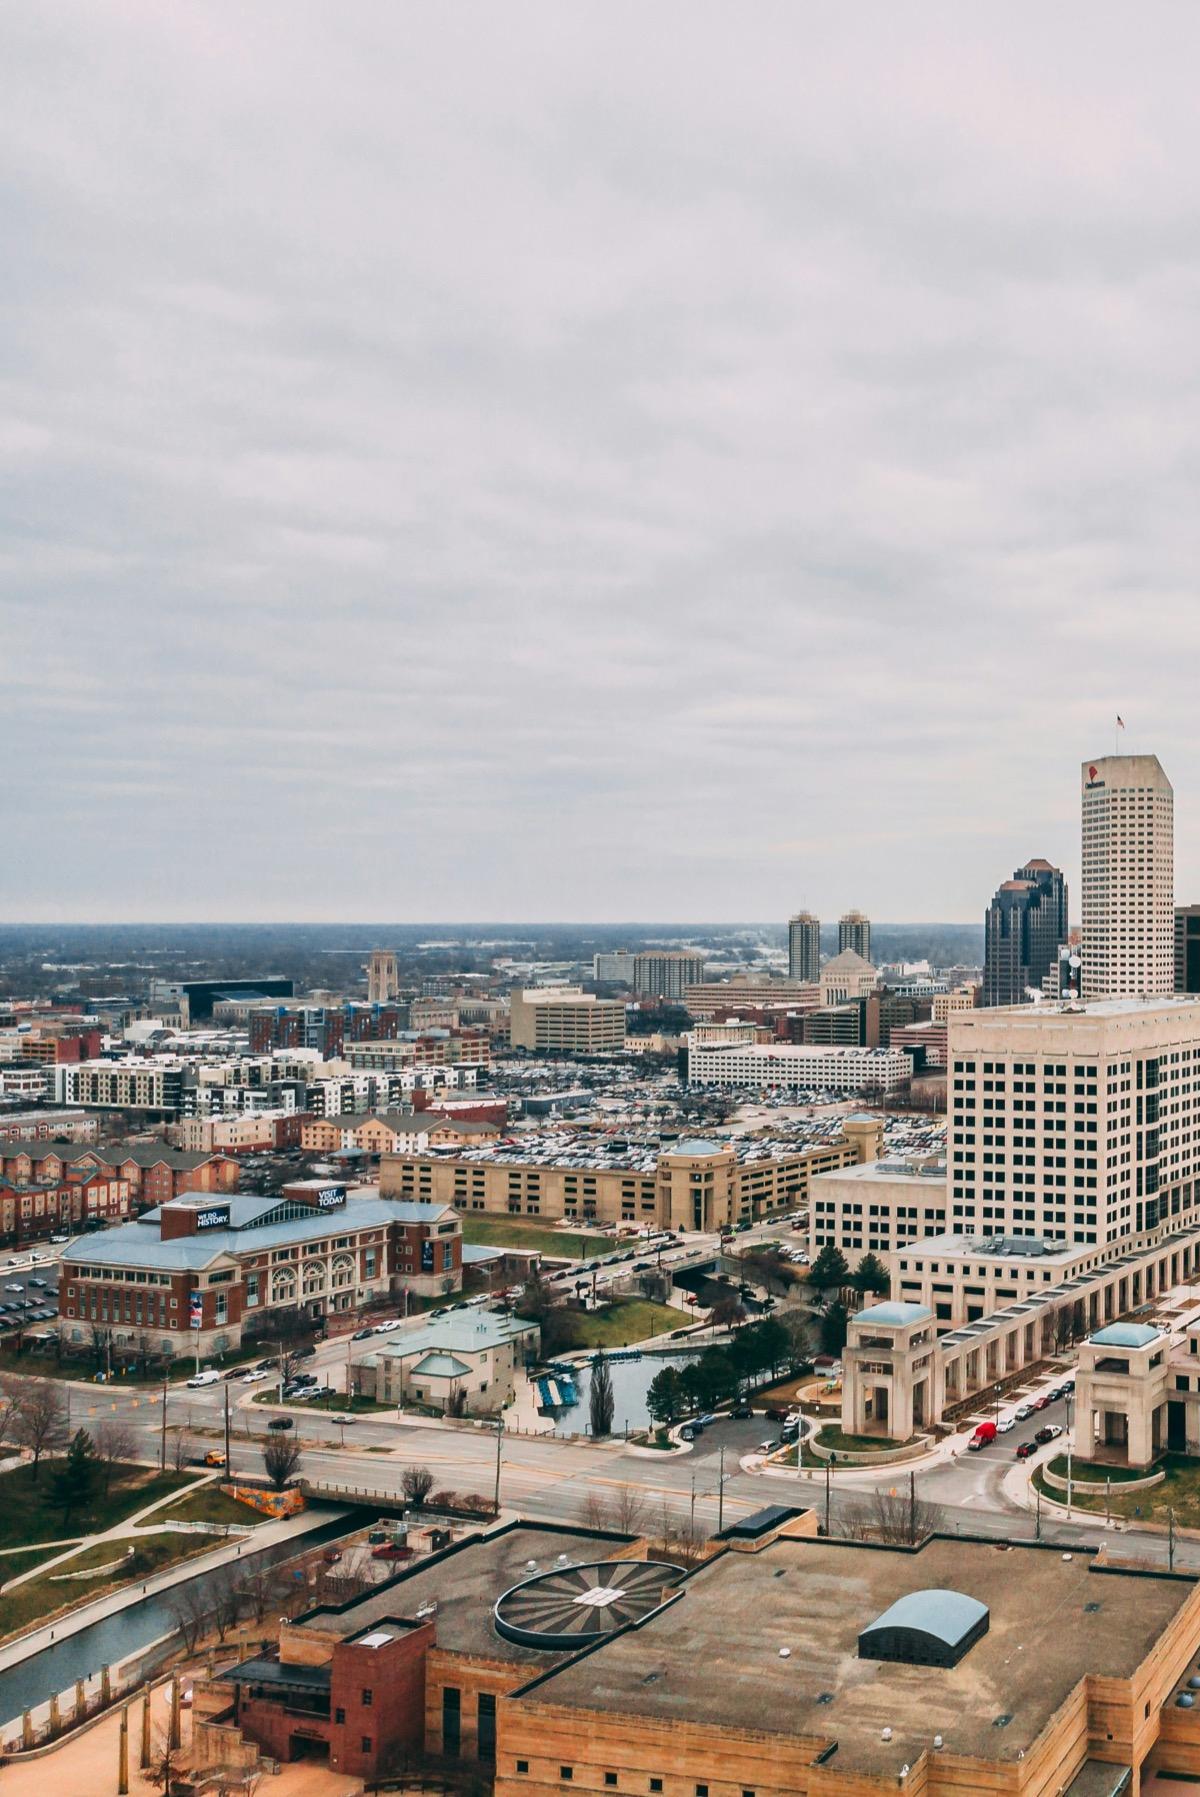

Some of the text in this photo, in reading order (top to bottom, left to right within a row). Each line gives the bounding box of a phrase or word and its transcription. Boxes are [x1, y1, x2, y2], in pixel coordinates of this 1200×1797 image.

[318, 1189, 338, 1200] VISIT
[318, 1195, 344, 1206] TODAY
[207, 1211, 217, 1219] DO
